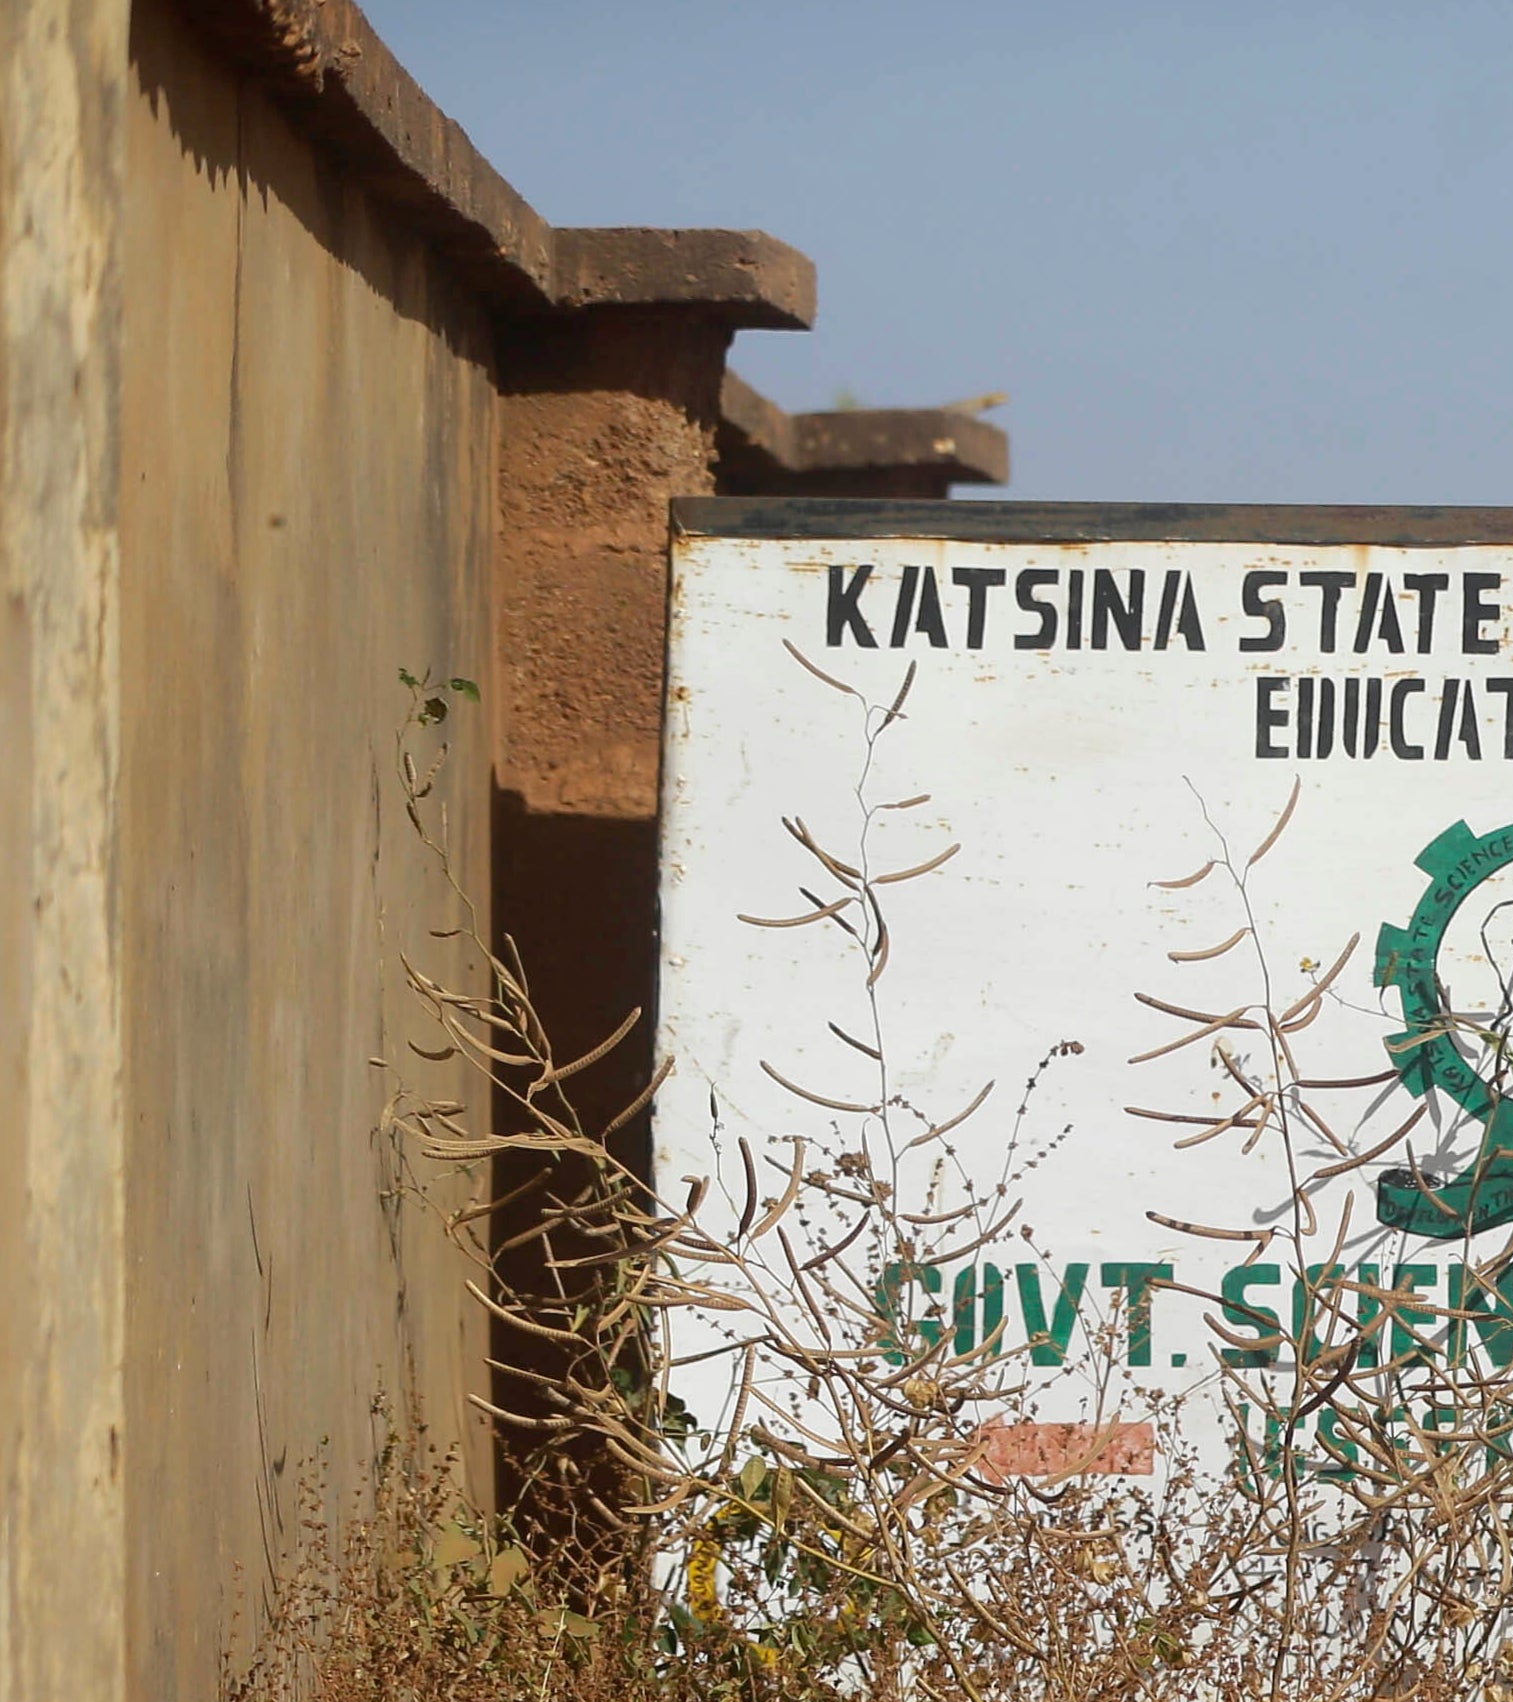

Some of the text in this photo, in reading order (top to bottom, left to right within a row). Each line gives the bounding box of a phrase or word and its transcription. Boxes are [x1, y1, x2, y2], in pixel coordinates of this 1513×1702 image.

[827, 564, 1206, 652] KATSINA
[1237, 570, 1501, 656] STATE
[876, 1262, 1188, 1367] GOVT.
